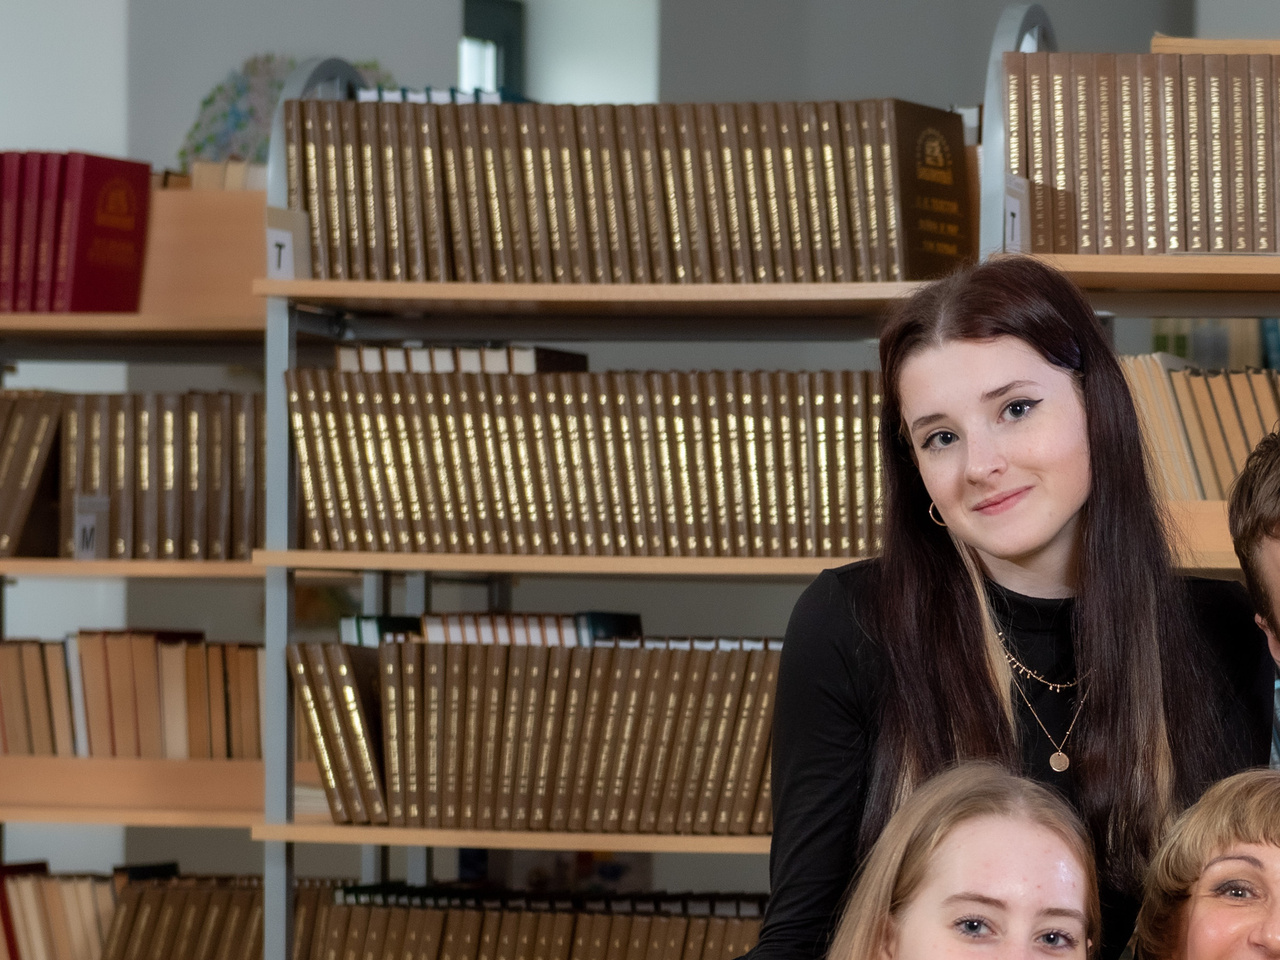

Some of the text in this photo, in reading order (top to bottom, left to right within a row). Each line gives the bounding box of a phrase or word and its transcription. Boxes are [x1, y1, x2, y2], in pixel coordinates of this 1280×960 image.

[1145, 138, 1155, 170] КАЗАКИ
[1166, 138, 1176, 170] КАЗАКИ
[1212, 139, 1222, 171] КАЗАКИ
[1257, 139, 1267, 171] КАЗАКИ
